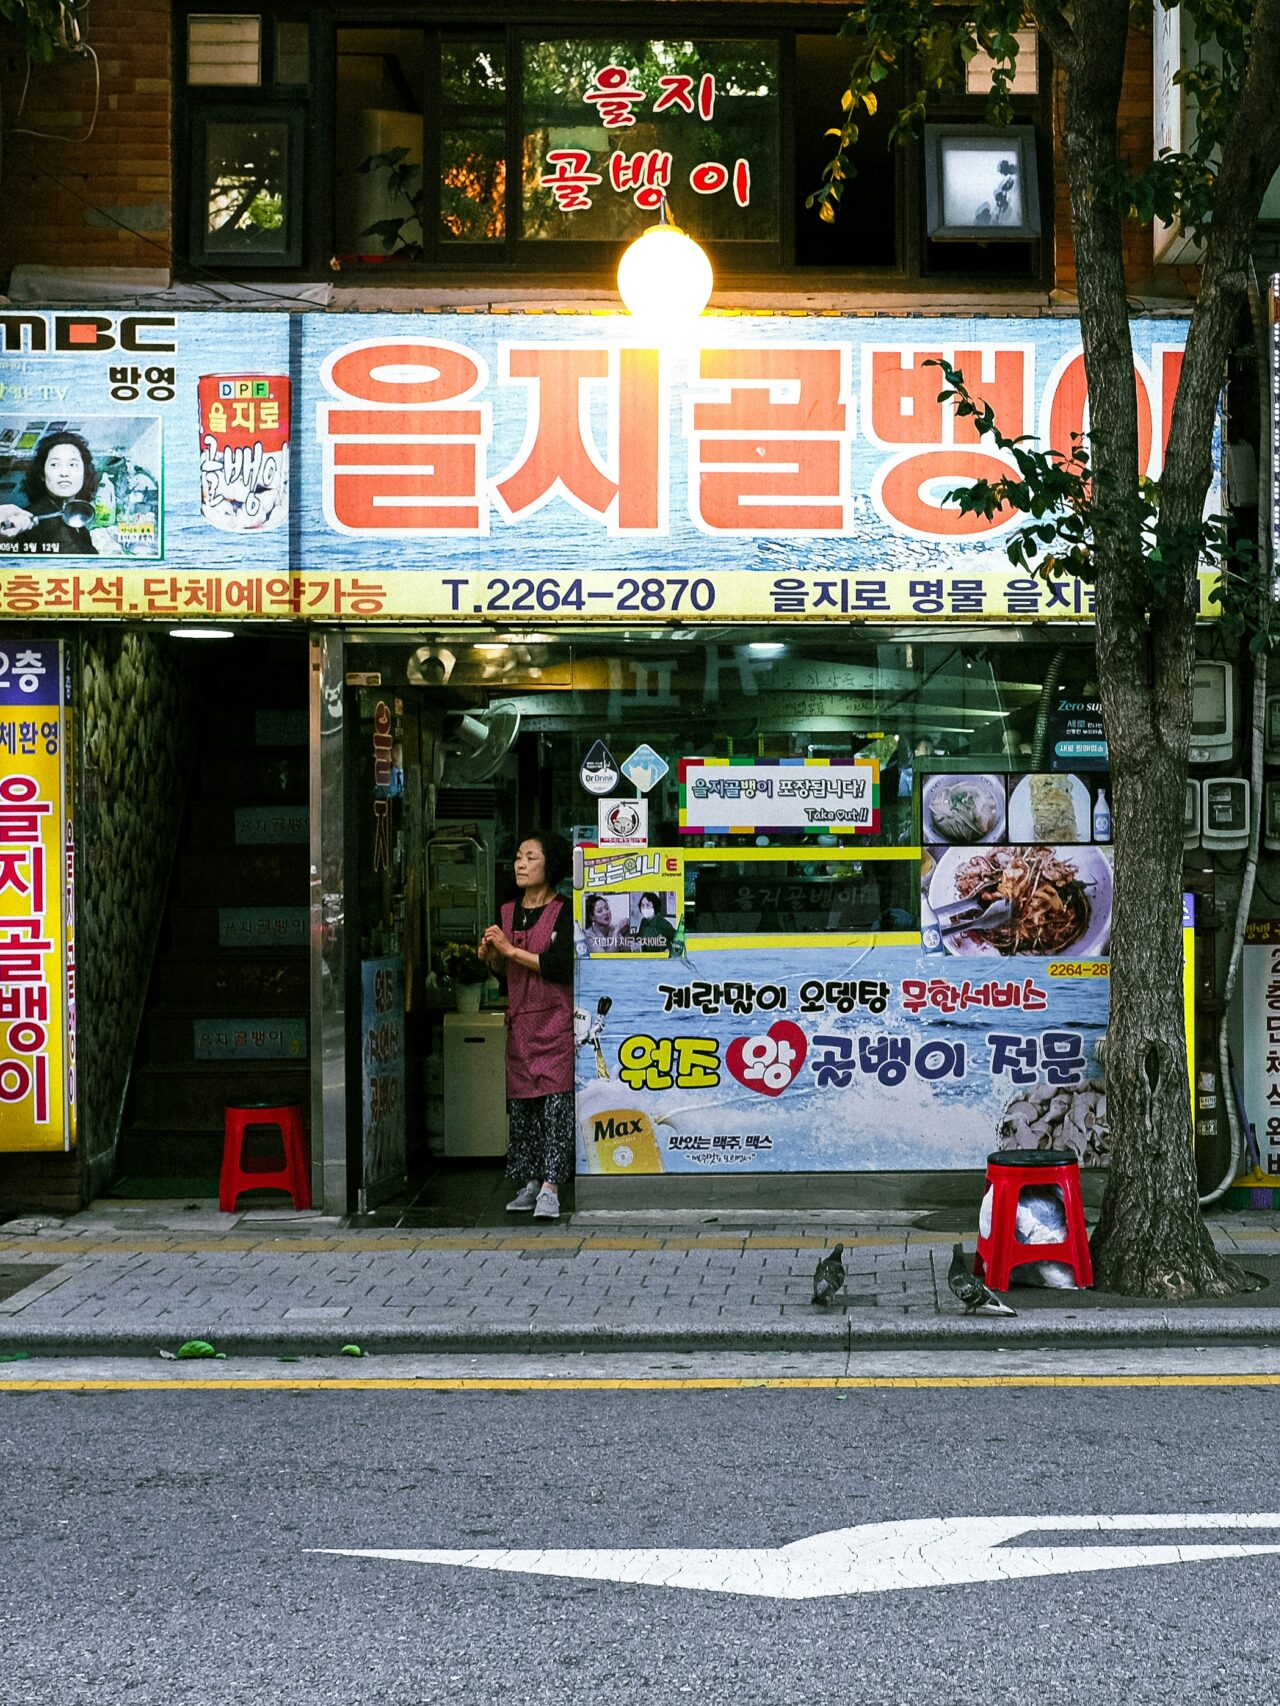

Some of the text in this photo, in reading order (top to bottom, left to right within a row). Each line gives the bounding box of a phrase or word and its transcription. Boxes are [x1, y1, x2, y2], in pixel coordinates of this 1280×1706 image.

[583, 65, 716, 128] 을지
[539, 148, 750, 211] 골뱅이
[109, 366, 176, 401] 방영
[208, 402, 280, 433] 을지로
[441, 577, 716, 614] T.2264-2870
[768, 576, 988, 614] 을지로 명물
[1057, 700, 1085, 711] Zero
[691, 779, 865, 799] 을지골뱅이 포장됩니다!
[805, 808, 834, 822] Take
[0, 775, 53, 1125] 을지골뱅이
[658, 980, 1048, 1014] 계란말이 오뎅탕 무한서비스
[619, 1032, 722, 1090] 원조
[740, 1033, 797, 1091] 왕
[987, 1031, 1086, 1087] 전문
[593, 1117, 644, 1142] Max
[668, 1135, 711, 1151] 맛있는
[745, 1134, 773, 1150] 맥스
